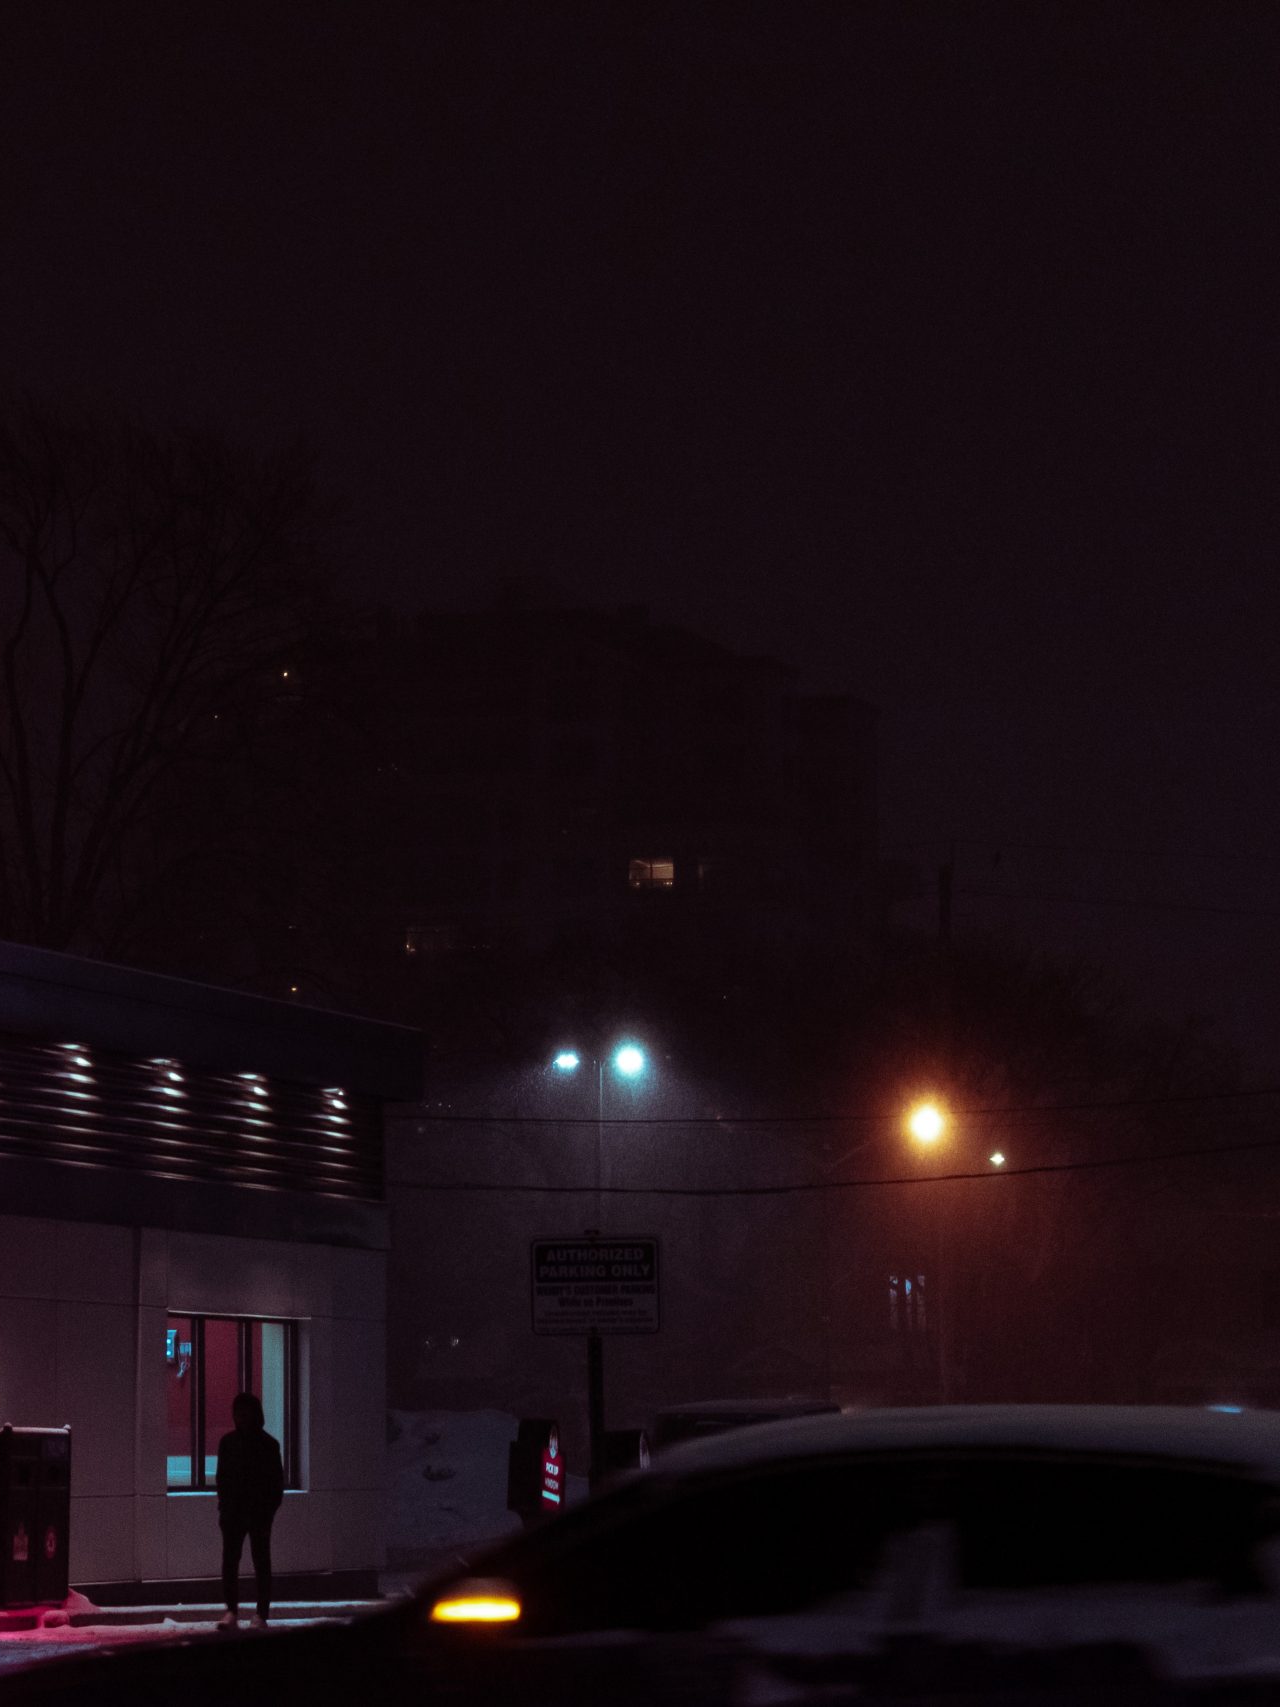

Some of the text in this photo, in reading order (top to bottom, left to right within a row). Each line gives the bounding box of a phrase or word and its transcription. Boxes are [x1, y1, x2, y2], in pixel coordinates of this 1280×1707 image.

[546, 1248, 645, 1262] AUTHORIZED
[539, 1263, 651, 1278] PARKING ONLY
